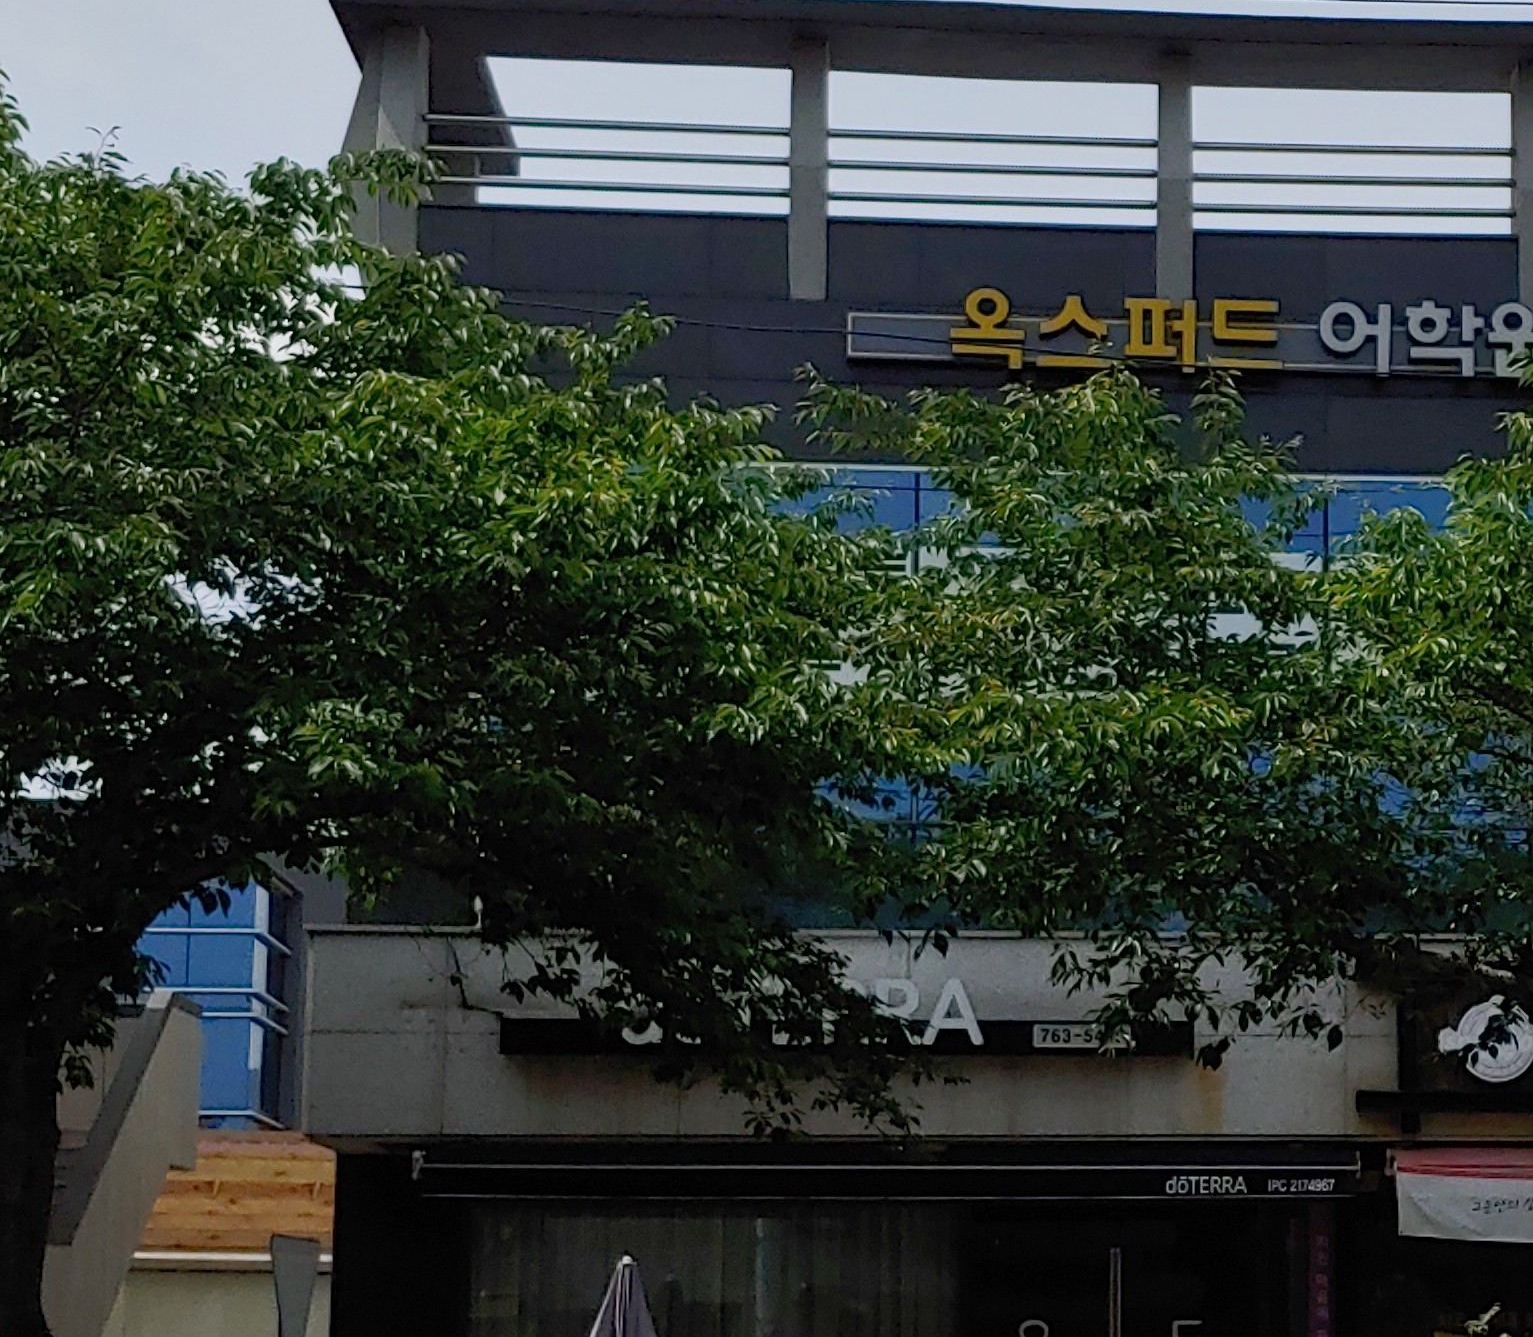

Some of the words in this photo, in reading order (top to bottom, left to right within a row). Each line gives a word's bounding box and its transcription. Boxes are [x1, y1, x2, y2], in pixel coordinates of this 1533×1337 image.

[950, 287, 1284, 372] 옥스퍼드
[1267, 1179, 1287, 1192] IPC
[1290, 1178, 1335, 1192] 2174967
